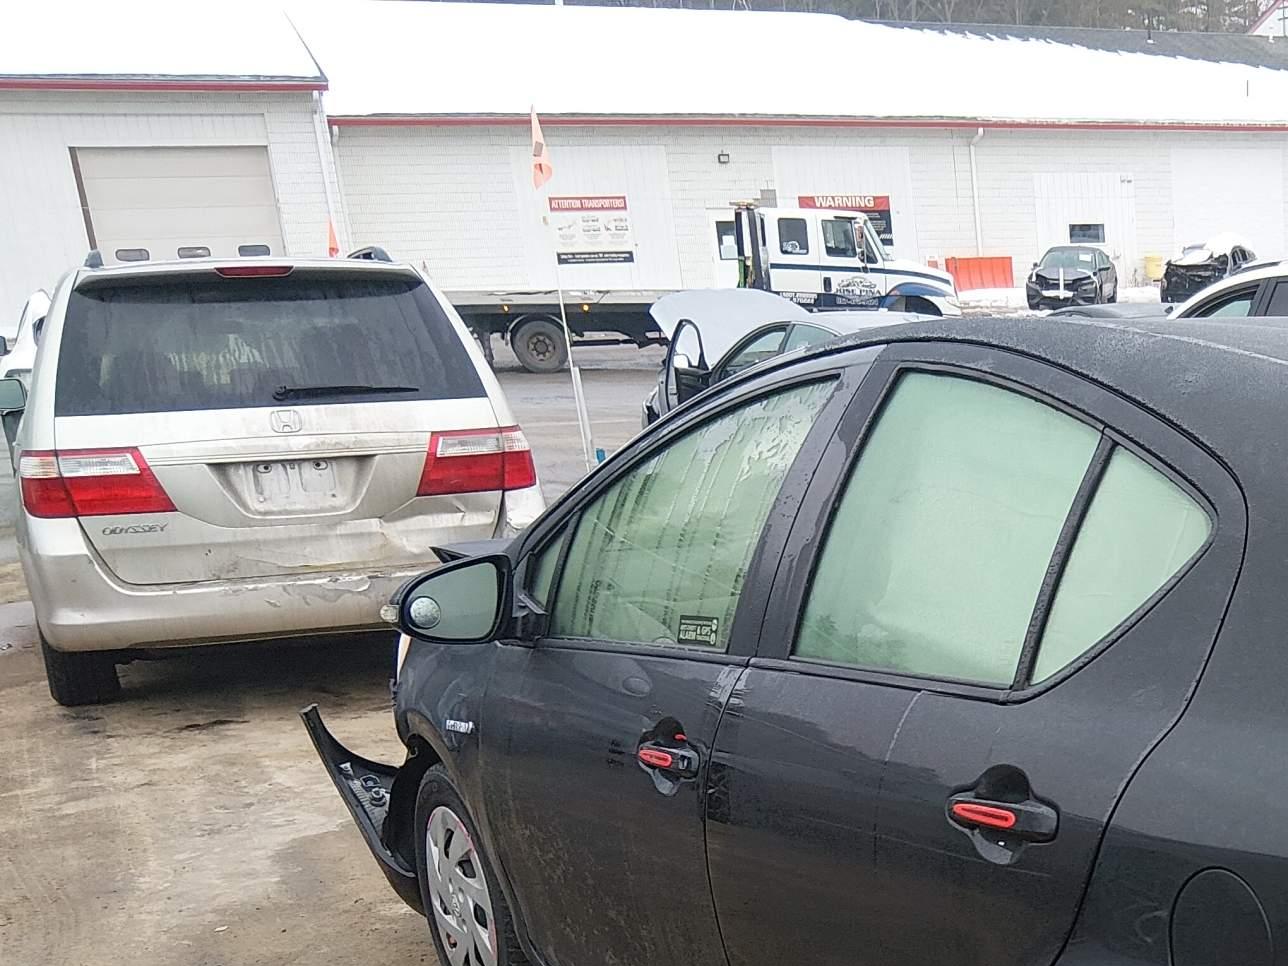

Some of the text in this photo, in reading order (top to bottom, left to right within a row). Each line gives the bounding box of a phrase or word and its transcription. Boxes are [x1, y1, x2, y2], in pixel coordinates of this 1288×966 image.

[551, 199, 581, 209] ATTENTION
[814, 196, 875, 208] WARNING
[102, 522, 168, 536] ODYSSEY
